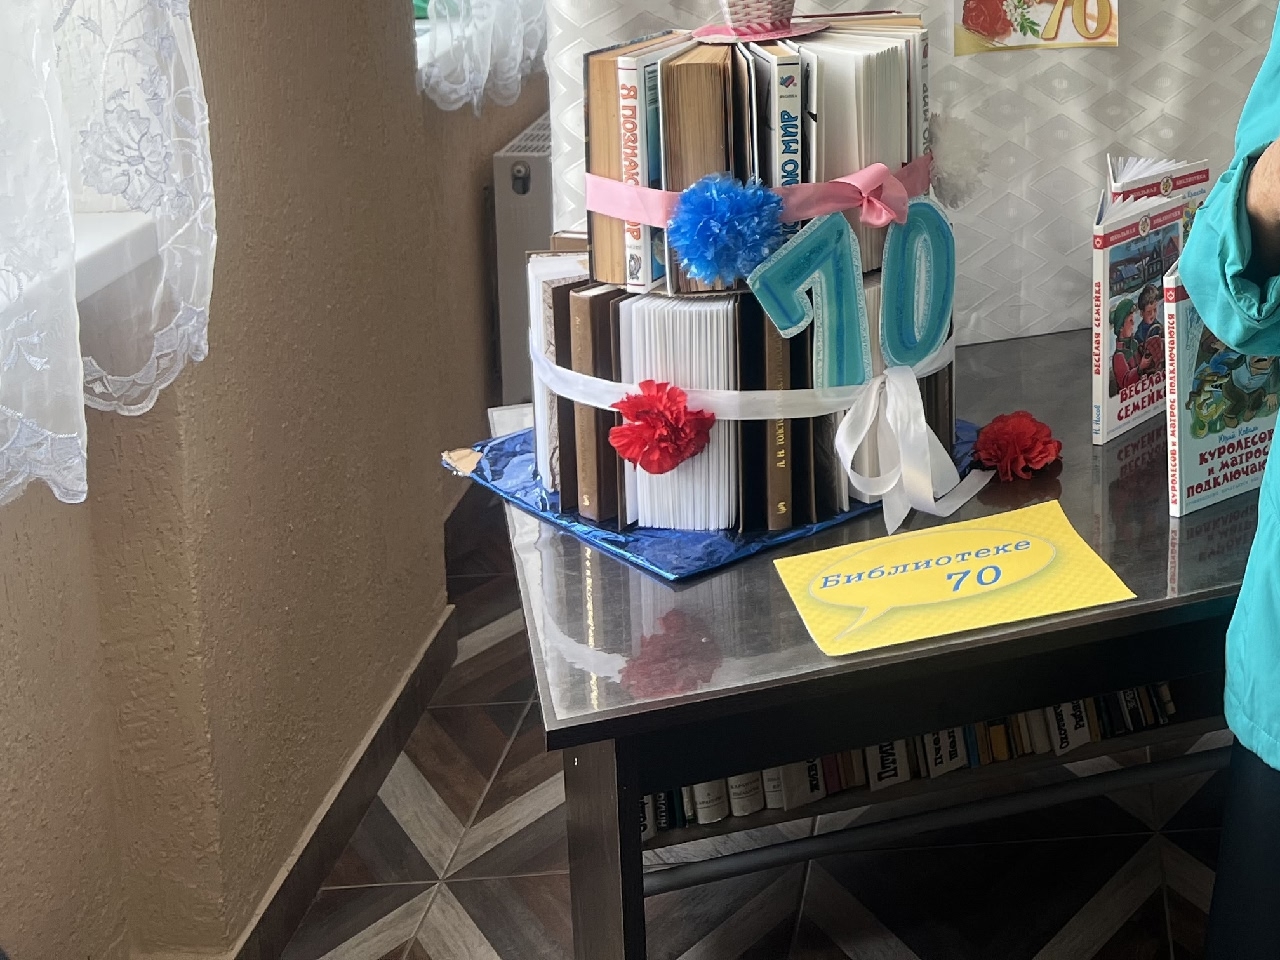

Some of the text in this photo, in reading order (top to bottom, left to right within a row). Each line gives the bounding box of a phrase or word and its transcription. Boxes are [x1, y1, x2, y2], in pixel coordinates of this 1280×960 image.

[621, 83, 638, 100] Я
[780, 110, 799, 155] МИР
[1093, 281, 1102, 328] СЕМЕЙКА
[1093, 330, 1102, 376] ВЕСЁЛАЯ
[1167, 313, 1177, 393] ПОДКЛЮЧАЮТСЯ
[1169, 393, 1179, 439] МАТРОС
[1170, 447, 1179, 506] КУРОЛЕСОВ
[819, 539, 1031, 590] Библиотеке
[946, 564, 1003, 593] 70
